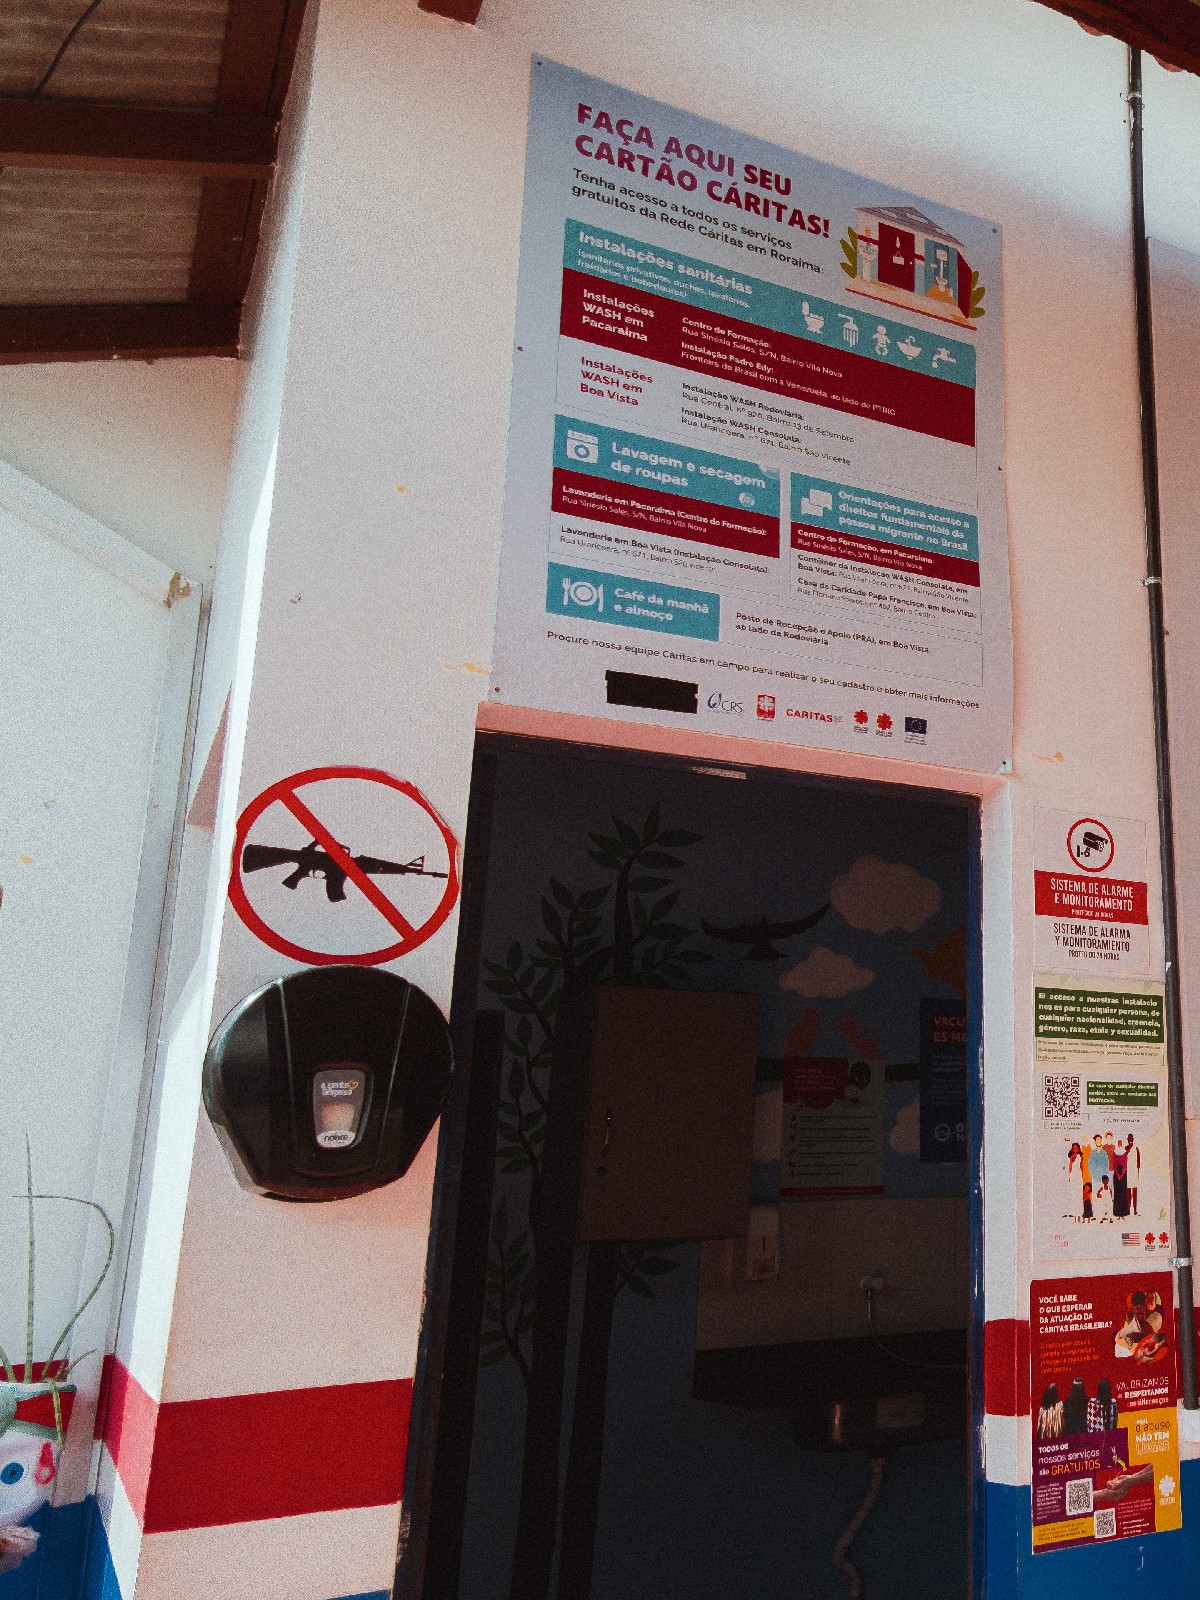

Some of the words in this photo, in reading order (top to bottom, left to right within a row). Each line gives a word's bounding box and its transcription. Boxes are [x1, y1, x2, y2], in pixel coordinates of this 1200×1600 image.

[576, 102, 655, 150] FAÇA
[663, 136, 735, 178] AQUI
[742, 162, 791, 197] SEU
[574, 134, 699, 193] CARTÃO
[706, 180, 831, 238] CÁRITAS!
[572, 167, 616, 192] Tenha
[619, 186, 667, 209] acesso
[670, 202, 678, 212] a
[681, 204, 718, 226] todos
[722, 219, 737, 231] os
[740, 224, 792, 251] serviços
[571, 183, 636, 215] gratuitos
[638, 204, 656, 219] da
[660, 212, 695, 232] Rede
[698, 223, 743, 248] Cáritas
[746, 242, 766, 255] em
[769, 248, 824, 275] Roraima:
[578, 230, 674, 273] Instalações
[677, 260, 752, 295] sanitárias
[582, 288, 655, 319] Instalações
[582, 301, 622, 321] WASH
[624, 315, 644, 328] em
[581, 314, 648, 342] Pacaraima
[681, 316, 712, 331] Centro
[713, 326, 725, 335] de
[726, 329, 771, 350] Formação:
[580, 356, 653, 385] Instalações
[680, 341, 727, 361] Instalação
[728, 354, 754, 367] Padre
[755, 362, 773, 375] Edy:
[579, 382, 604, 398] Boa
[606, 389, 638, 406] Vista
[580, 369, 620, 388] WASH
[622, 382, 642, 394] em
[610, 459, 632, 473] de
[634, 465, 688, 489] roupas
[611, 441, 682, 471] Lavagem
[685, 462, 696, 472] e
[699, 465, 766, 491] secagem
[838, 490, 901, 514] Orientações
[903, 507, 926, 519] para
[927, 513, 961, 527] acesso
[963, 521, 969, 529] a
[838, 502, 878, 519] direitos
[880, 512, 949, 536] fundamentais
[951, 529, 964, 539] da
[838, 515, 876, 533] pessoa
[878, 524, 924, 543] migrante
[925, 536, 939, 545] no
[940, 537, 968, 552] Brasil
[613, 603, 622, 612] e
[625, 603, 673, 623] almoço
[614, 587, 644, 602] Café
[646, 594, 663, 606] da
[666, 597, 709, 614] manhã
[735, 611, 761, 623] Posto
[761, 616, 774, 626] de
[775, 619, 818, 635] Recepção
[827, 628, 851, 641] Apoio
[893, 640, 908, 649] Boa
[747, 624, 768, 635] lado
[770, 628, 781, 637] da
[783, 630, 828, 646] Rodoviária
[546, 630, 589, 645] Procure
[591, 639, 622, 650] nossa
[623, 644, 660, 659] equipe
[662, 649, 697, 663] Cáritas
[699, 657, 714, 666] em
[716, 659, 750, 673] campo
[752, 666, 773, 676] para
[774, 668, 809, 681] realizar
[818, 677, 835, 685] seu
[836, 678, 875, 691] cadastro
[884, 686, 907, 697] obter
[908, 690, 928, 700] mais
[721, 700, 743, 713] CRS
[785, 707, 833, 723] CARITAS
[1050, 878, 1086, 893] SISTEMA
[1089, 882, 1098, 894] DE
[1101, 884, 1134, 899] ALARME
[1054, 893, 1059, 904] E
[1062, 893, 1133, 912] MONITORAMENTO
[1053, 923, 1086, 936] SISTEMA
[1089, 926, 1098, 937] DE
[1101, 927, 1131, 939] ALARMA
[1055, 936, 1060, 946] Y
[1062, 936, 1130, 952] MONITORAMIENTO
[1039, 1294, 1058, 1304] VOCÊ
[1046, 1305, 1060, 1313] QUE
[1062, 1303, 1092, 1312] ESPERAR
[1039, 1316, 1048, 1324] DA
[1050, 1313, 1082, 1322] ATUAÇÃO
[1040, 1324, 1068, 1333] CÁRITAS
[1070, 1321, 1112, 1331] BRASILEIRA?
[1117, 1377, 1169, 1390] VALORIZAMOS
[1136, 1433, 1153, 1443] NÃO
[1154, 1432, 1169, 1440] TEM
[1038, 1455, 1066, 1464] nossos
[1068, 1450, 1100, 1461] serviços
[1051, 1460, 1101, 1476] GRATUITOS
